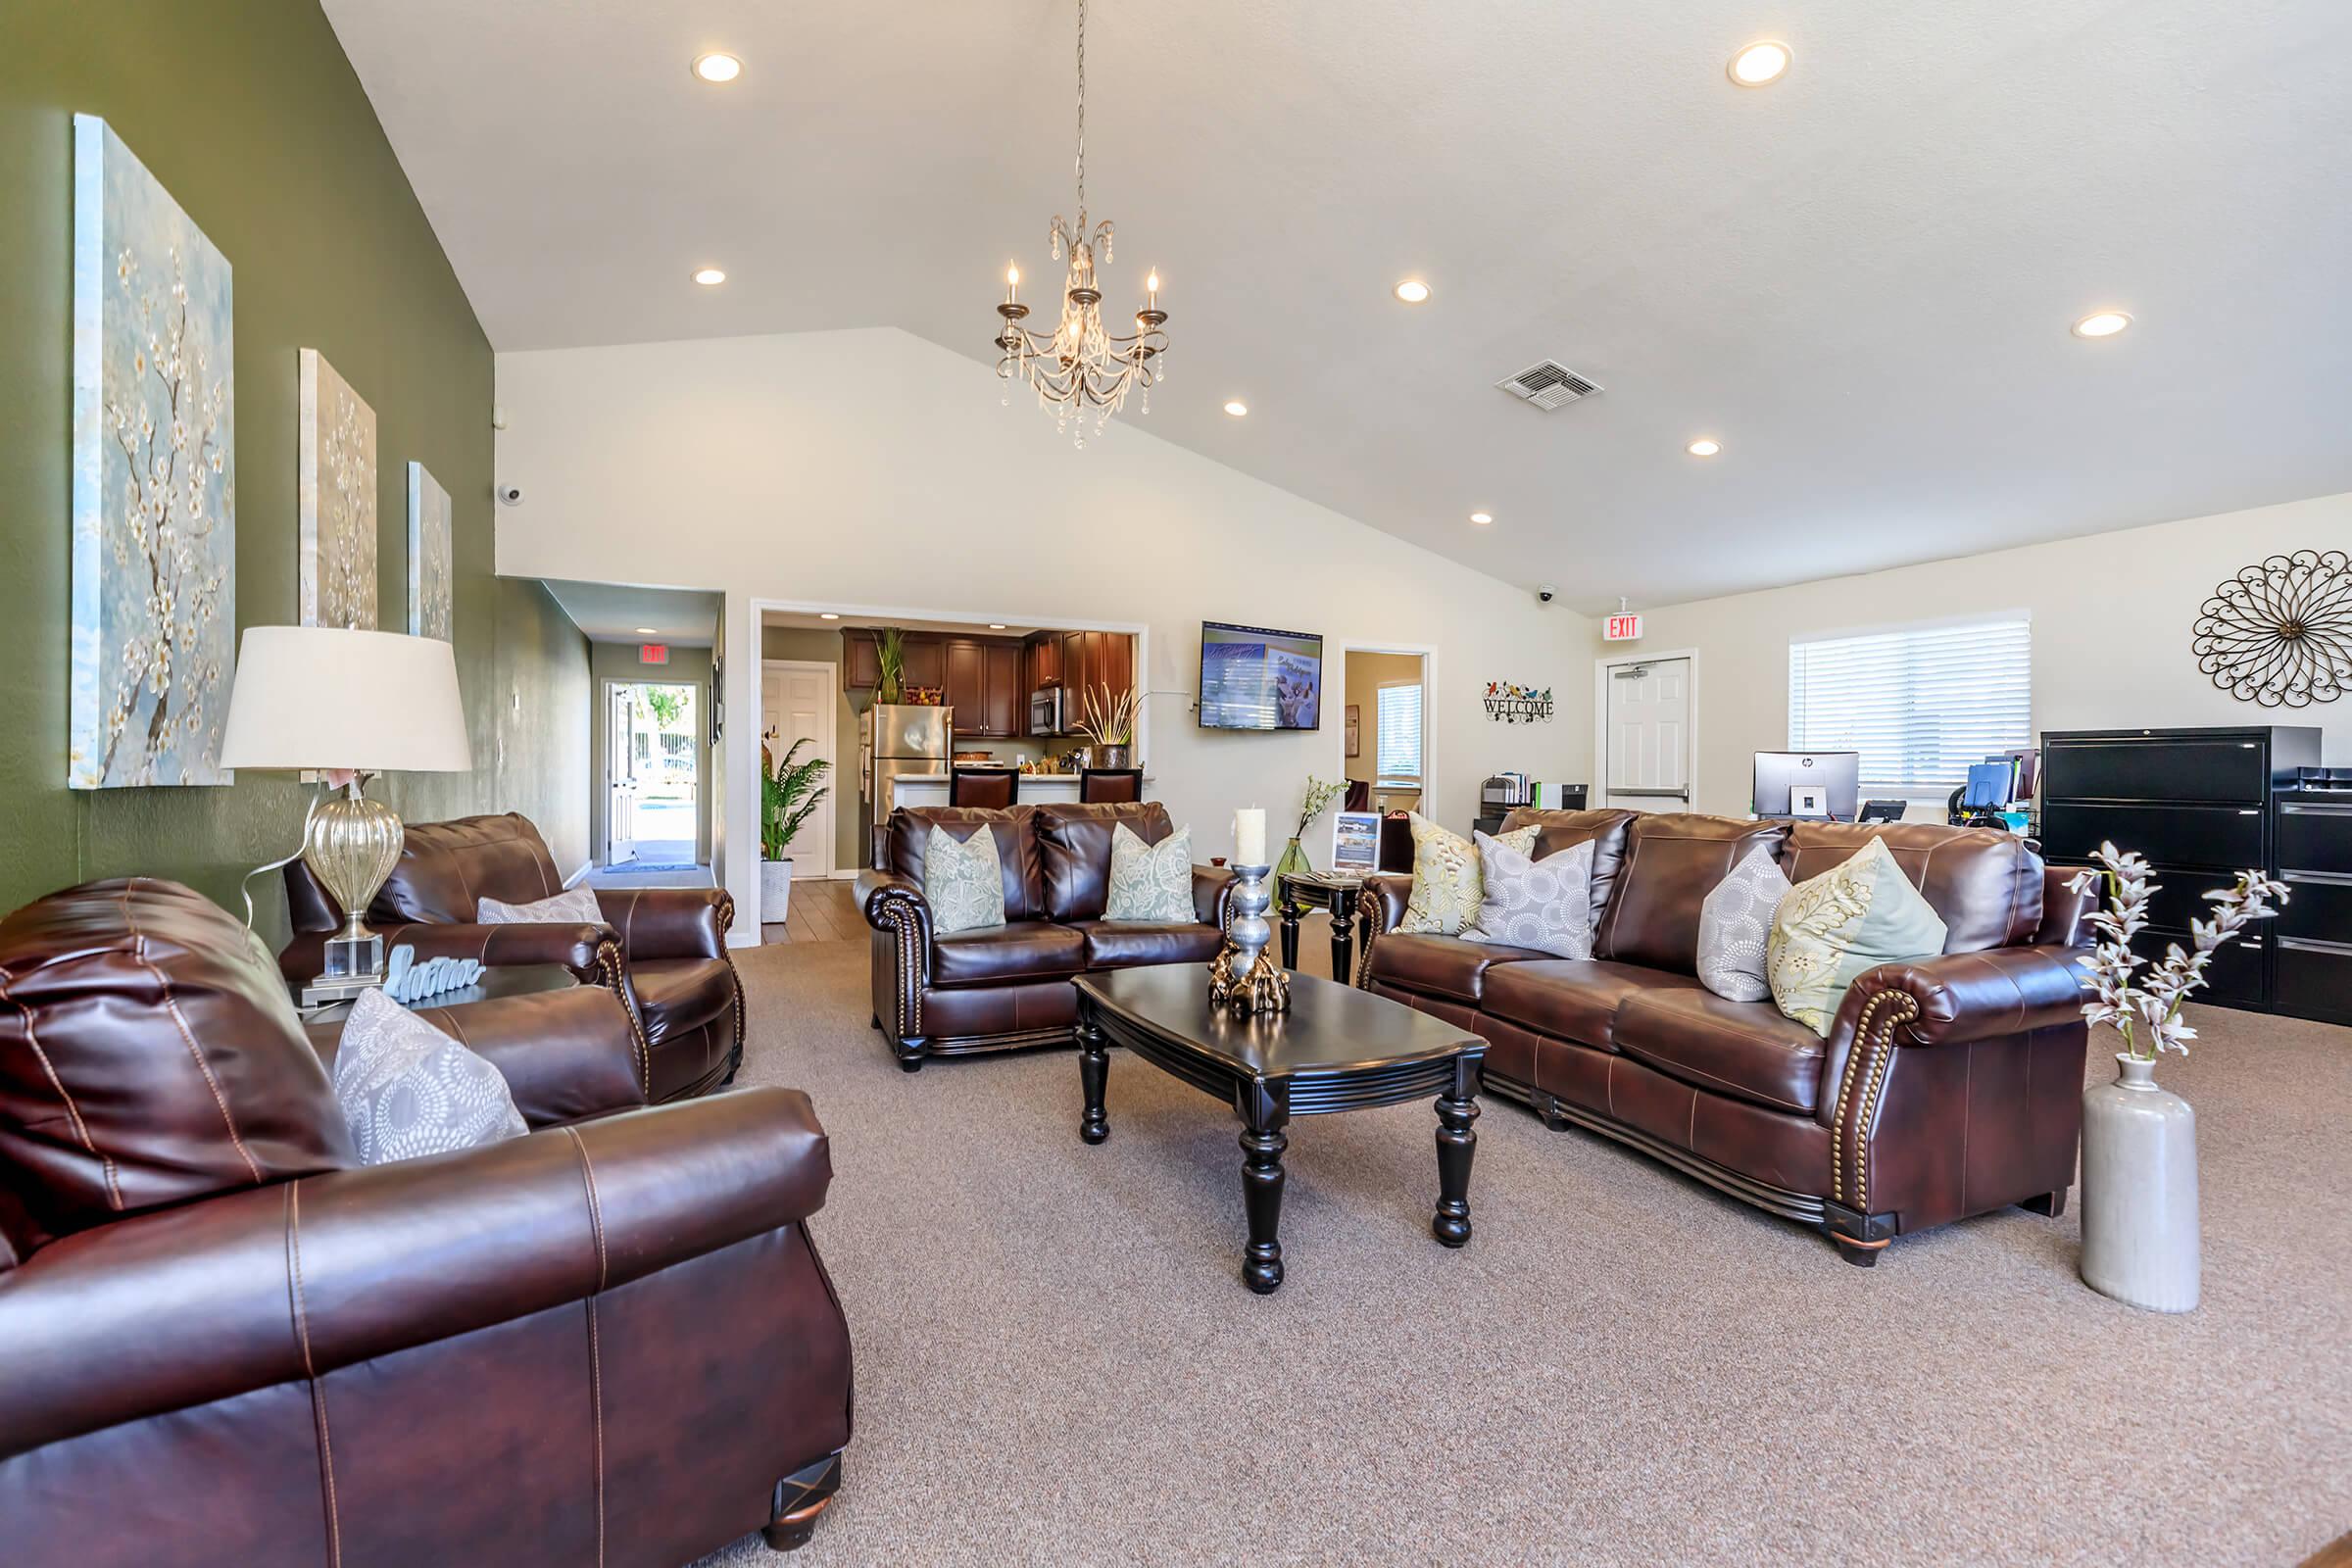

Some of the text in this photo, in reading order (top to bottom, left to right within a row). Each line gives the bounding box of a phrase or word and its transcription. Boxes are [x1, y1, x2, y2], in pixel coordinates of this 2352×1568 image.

[1609, 616, 1638, 638] EXIT
[642, 645, 666, 663] EXIT
[1484, 699, 1554, 715] WELCOME
